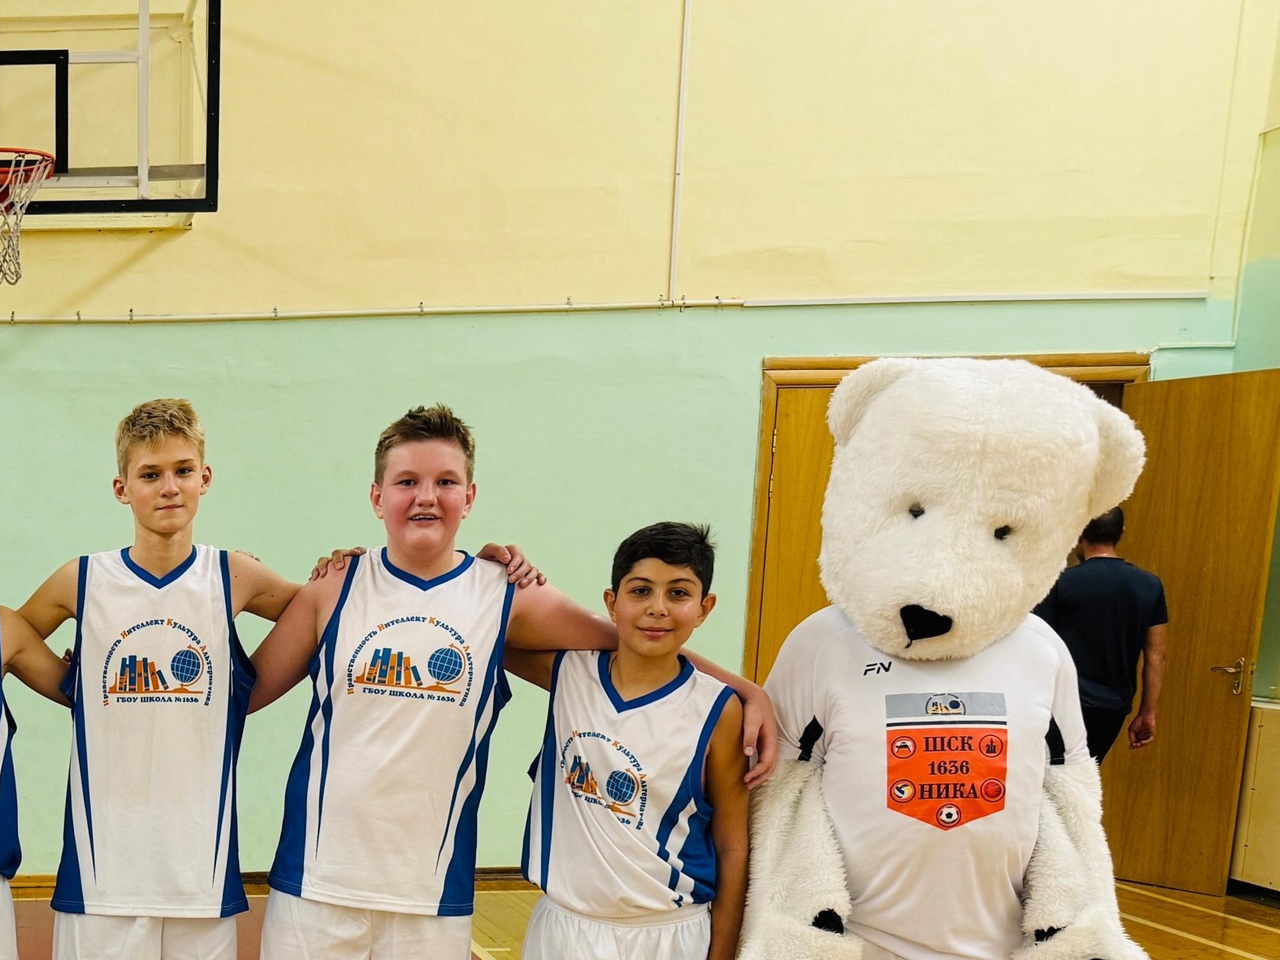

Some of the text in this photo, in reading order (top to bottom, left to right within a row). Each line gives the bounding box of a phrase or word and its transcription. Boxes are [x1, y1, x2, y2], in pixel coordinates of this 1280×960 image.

[166, 618, 201, 645] Культура
[377, 615, 427, 632] Интеллект
[428, 617, 466, 645] Культура
[362, 687, 387, 696] ГБОУ
[388, 690, 425, 700] ШКОЛА
[436, 695, 456, 703] 1636
[923, 736, 974, 752] ШСК
[928, 760, 970, 775] 1636
[918, 783, 980, 800] НИКА
